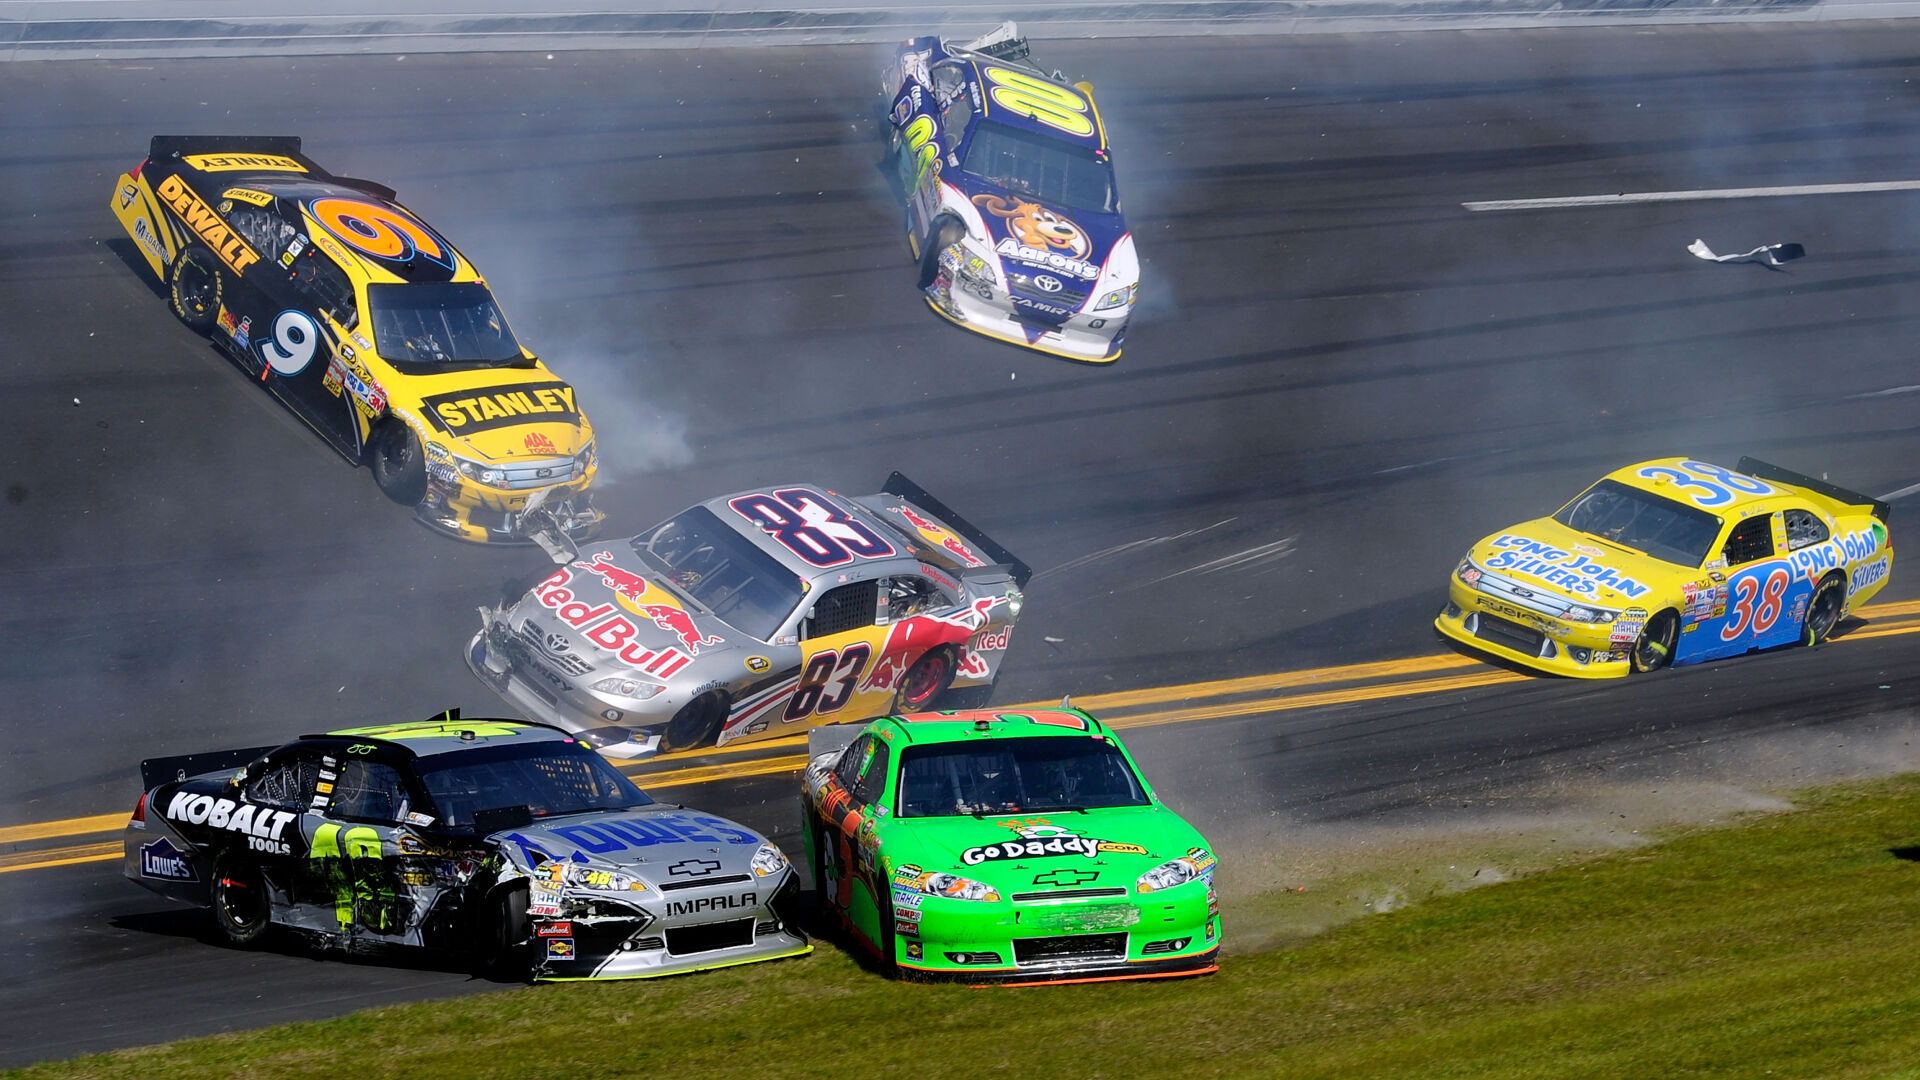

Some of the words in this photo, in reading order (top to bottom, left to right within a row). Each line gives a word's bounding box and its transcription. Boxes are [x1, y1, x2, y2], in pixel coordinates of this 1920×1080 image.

[984, 66, 1094, 136] 00
[201, 157, 298, 168] STANLEY
[228, 189, 268, 202] STANLEY
[159, 176, 257, 273] DEWALT
[311, 199, 447, 264] 9
[995, 238, 1099, 279] Aaron's
[257, 310, 317, 376] 9
[368, 394, 385, 412] 3M
[438, 386, 576, 428] STANLEY
[1637, 460, 1775, 507] 38
[729, 488, 897, 567] 83
[1492, 535, 1571, 562] LONG
[1789, 545, 1837, 578] LONG
[1721, 568, 1790, 641] 38
[535, 567, 616, 629] Red
[581, 613, 695, 680] Bull
[975, 625, 1009, 650] Red
[1613, 625, 1640, 634] MAHLE
[783, 642, 872, 722] 83
[167, 791, 296, 841] KOBALT
[248, 836, 290, 855] TOOLS
[145, 853, 191, 878] LOWE'S
[586, 871, 612, 886] 48
[894, 876, 921, 889] MOOG
[667, 892, 757, 917] IMPALA
[895, 891, 923, 906] MAHLE
[896, 908, 915, 918] COMP
